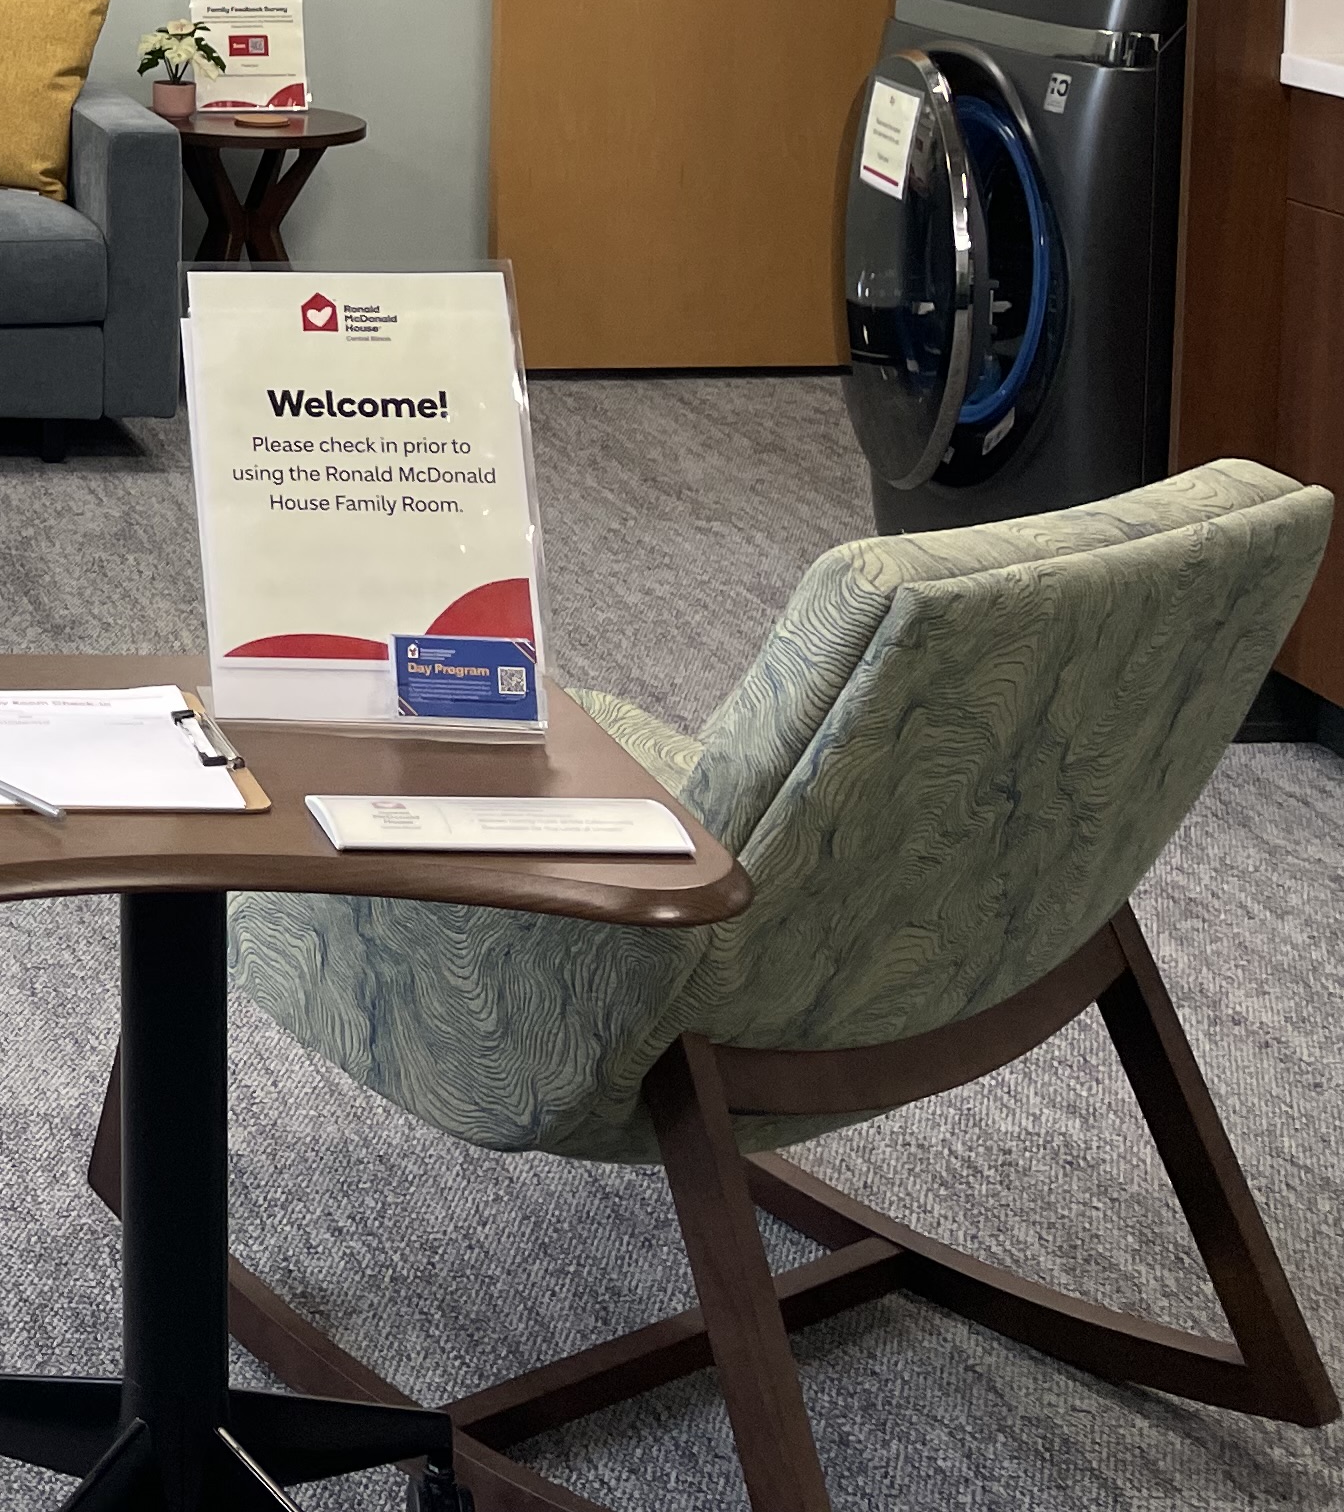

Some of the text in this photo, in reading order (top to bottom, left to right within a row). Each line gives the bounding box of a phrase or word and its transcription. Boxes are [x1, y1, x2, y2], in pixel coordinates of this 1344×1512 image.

[343, 305, 380, 313] Ronald
[344, 315, 398, 323] McDonald
[267, 389, 448, 418] Welcome!
[252, 437, 471, 457] Please check in prior to
[233, 464, 497, 485] using the Ronald McDonald
[269, 494, 464, 516] House Family Room.
[407, 662, 490, 677] Day Program
